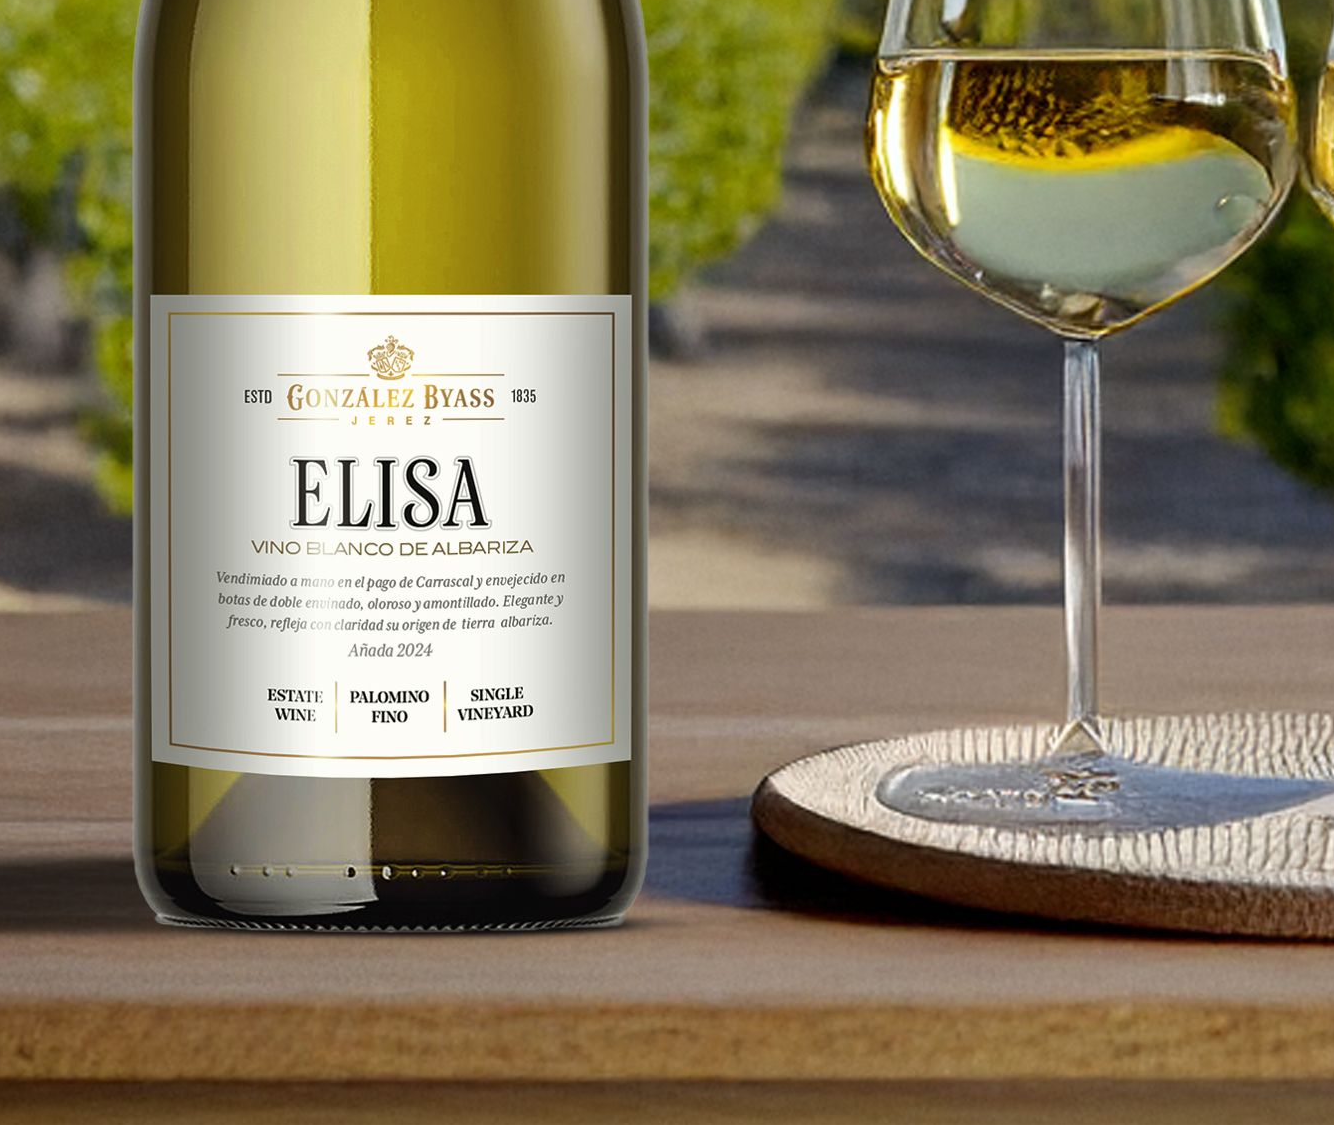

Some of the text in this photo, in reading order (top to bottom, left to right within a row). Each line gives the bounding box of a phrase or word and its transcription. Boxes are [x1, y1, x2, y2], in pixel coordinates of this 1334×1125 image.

[244, 389, 272, 404] ESTD
[511, 389, 536, 403] 1835
[289, 455, 492, 530] ELISA
[252, 540, 534, 556] VINO BLANCO DE ALBARIZA
[216, 571, 565, 591] Vendimiado a mano en el pago de Carrascal y envejecido en
[218, 593, 564, 613] botas de doble envinado, oloroso y amontillado. Elegante y
[226, 614, 552, 634] fresco, refleja con claridad su origen de tierra albariza.
[348, 643, 433, 658] Añada 2024
[267, 688, 323, 703] ESTATE
[349, 690, 429, 704] PALOMINO
[470, 687, 524, 702] SINGLE
[275, 708, 316, 722] WINE
[371, 711, 408, 723] FINO
[457, 704, 534, 721] VINEYARD
